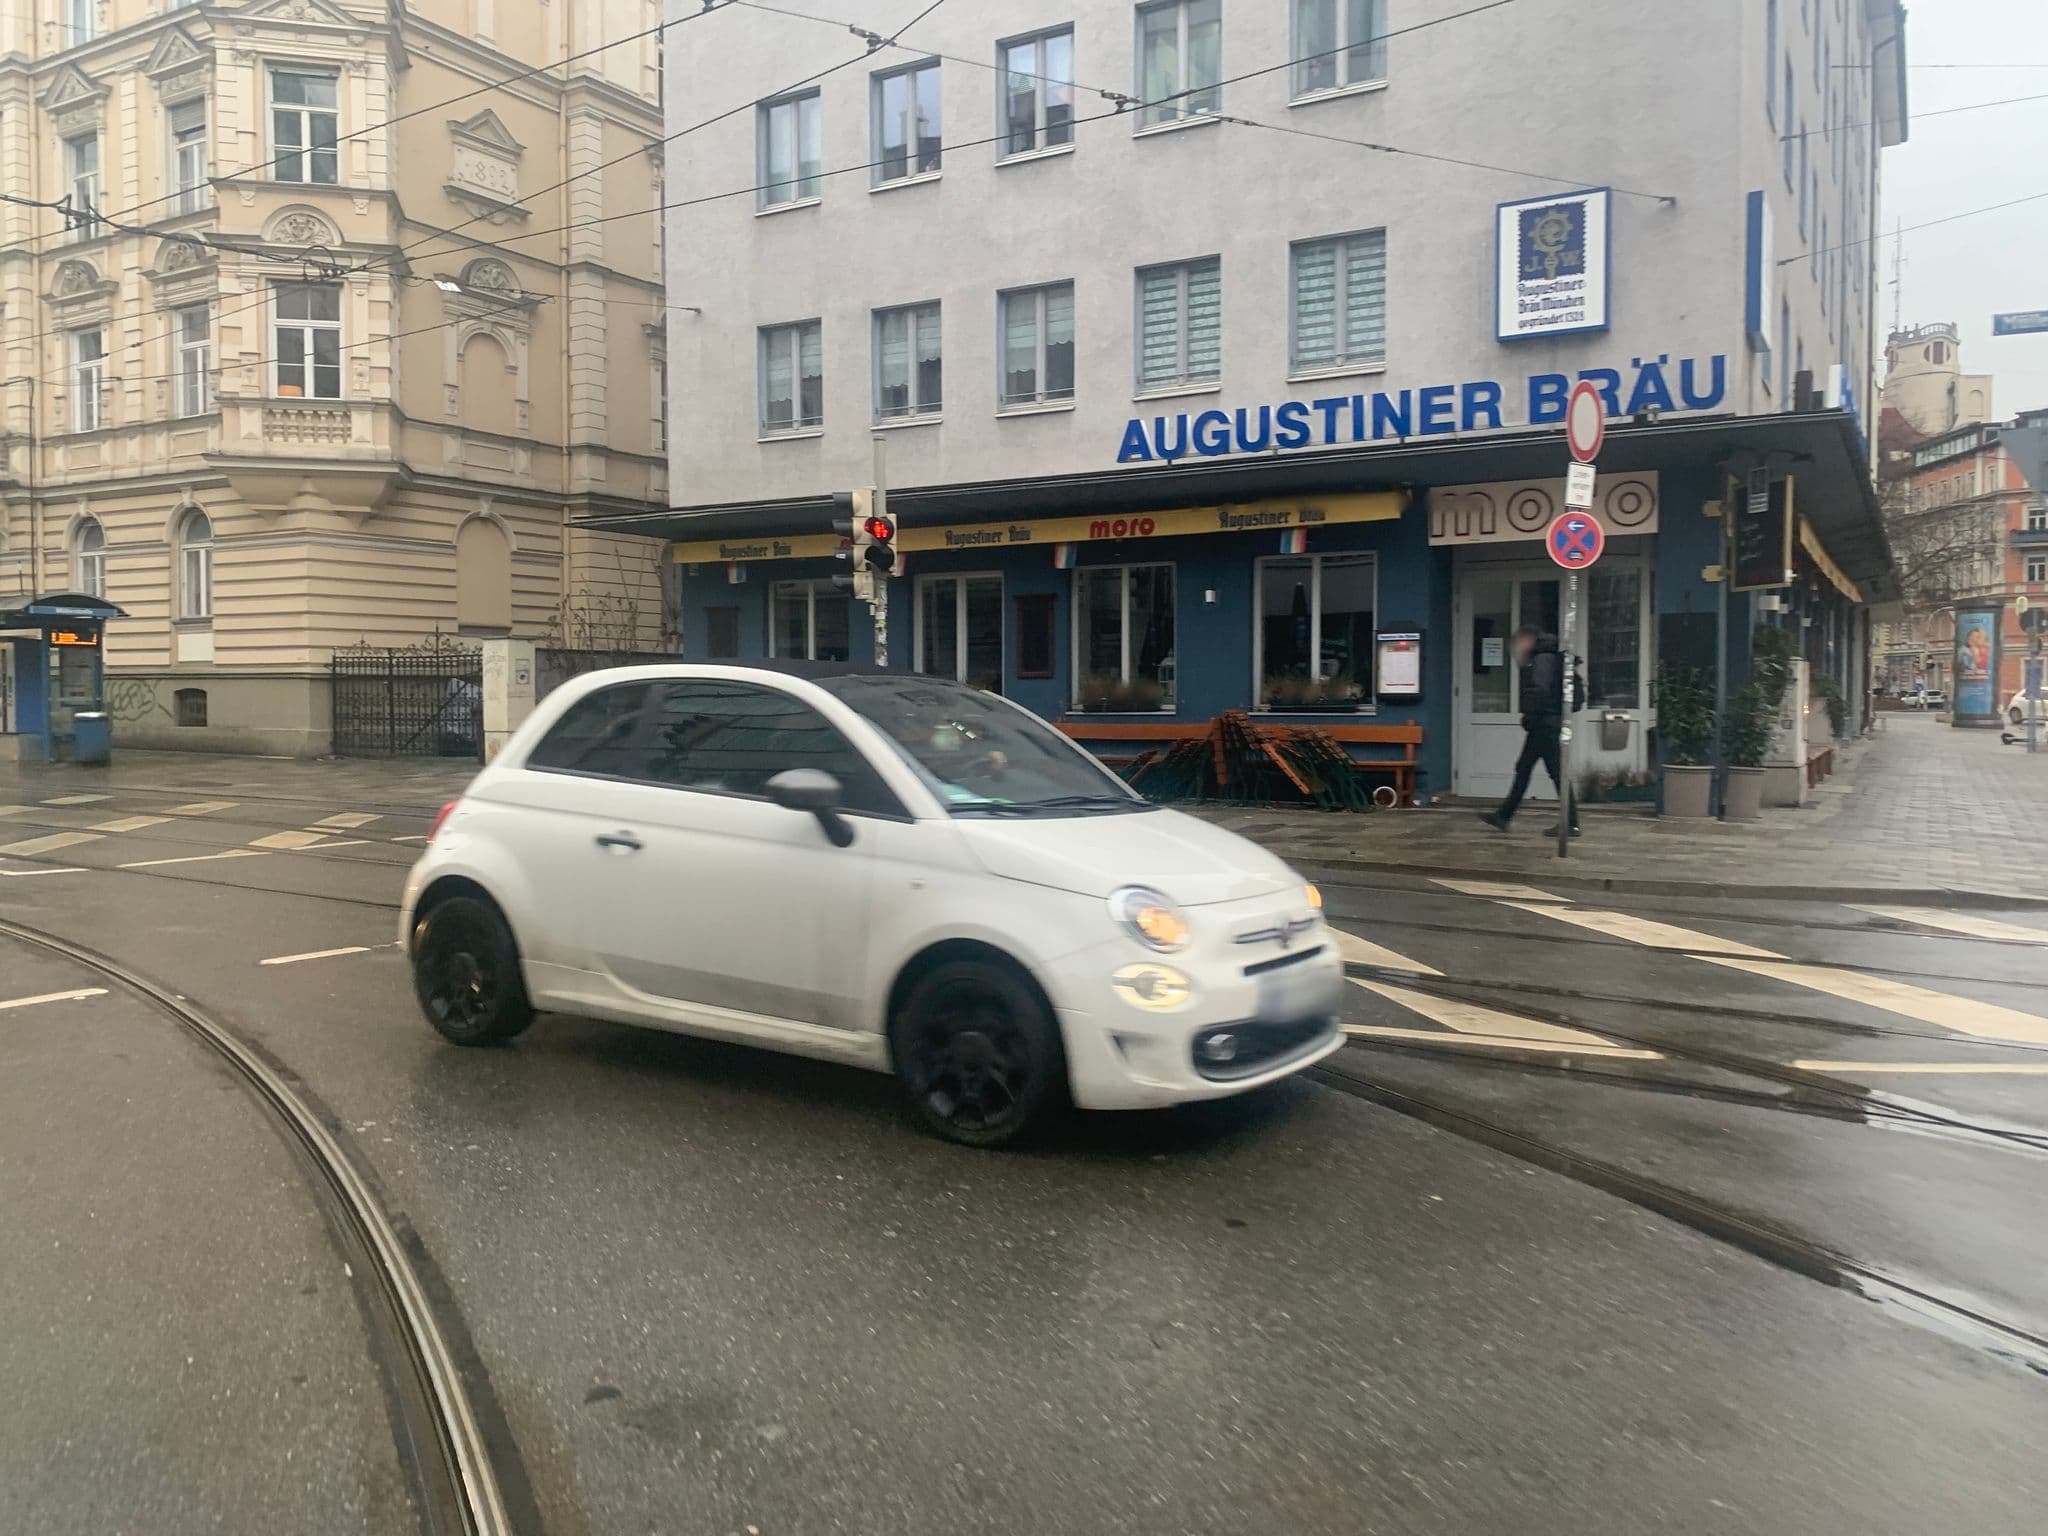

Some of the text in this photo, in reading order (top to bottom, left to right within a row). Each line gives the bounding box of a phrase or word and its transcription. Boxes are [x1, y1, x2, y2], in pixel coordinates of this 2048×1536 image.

[1518, 279, 1584, 299] Augustiner
[1116, 354, 1727, 463] AUGUSTINER BRÄU
[1430, 479, 1656, 538] moo
[1090, 516, 1156, 539] moro
[1219, 511, 1291, 530] Augustiner
[945, 529, 1003, 549] Augustiner
